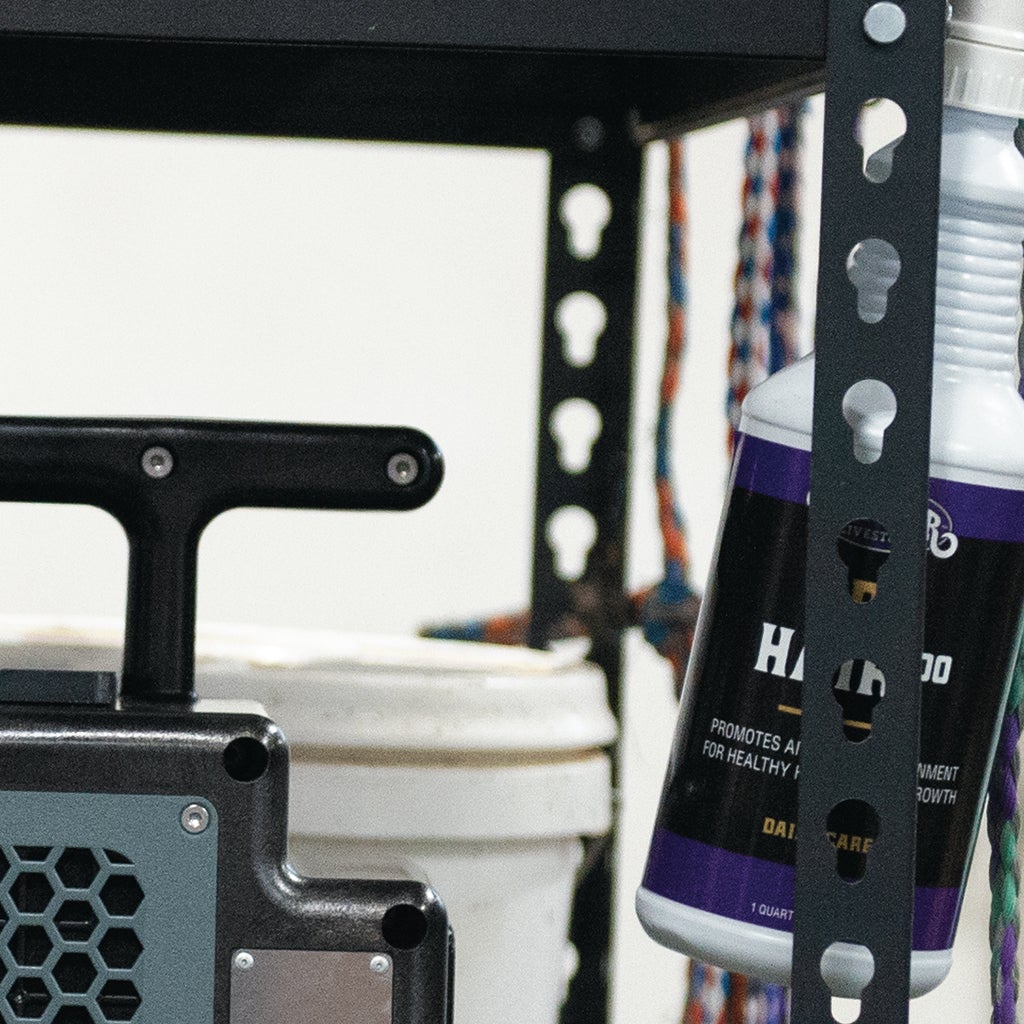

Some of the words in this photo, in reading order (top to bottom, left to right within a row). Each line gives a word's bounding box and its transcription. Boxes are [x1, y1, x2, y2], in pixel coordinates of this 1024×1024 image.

[710, 717, 782, 752] PROMOTES
[702, 740, 726, 760] FOR
[726, 747, 792, 778] HEALTHY
[761, 816, 798, 840] DAI
[751, 902, 757, 914] 1
[758, 903, 795, 921] QUART
